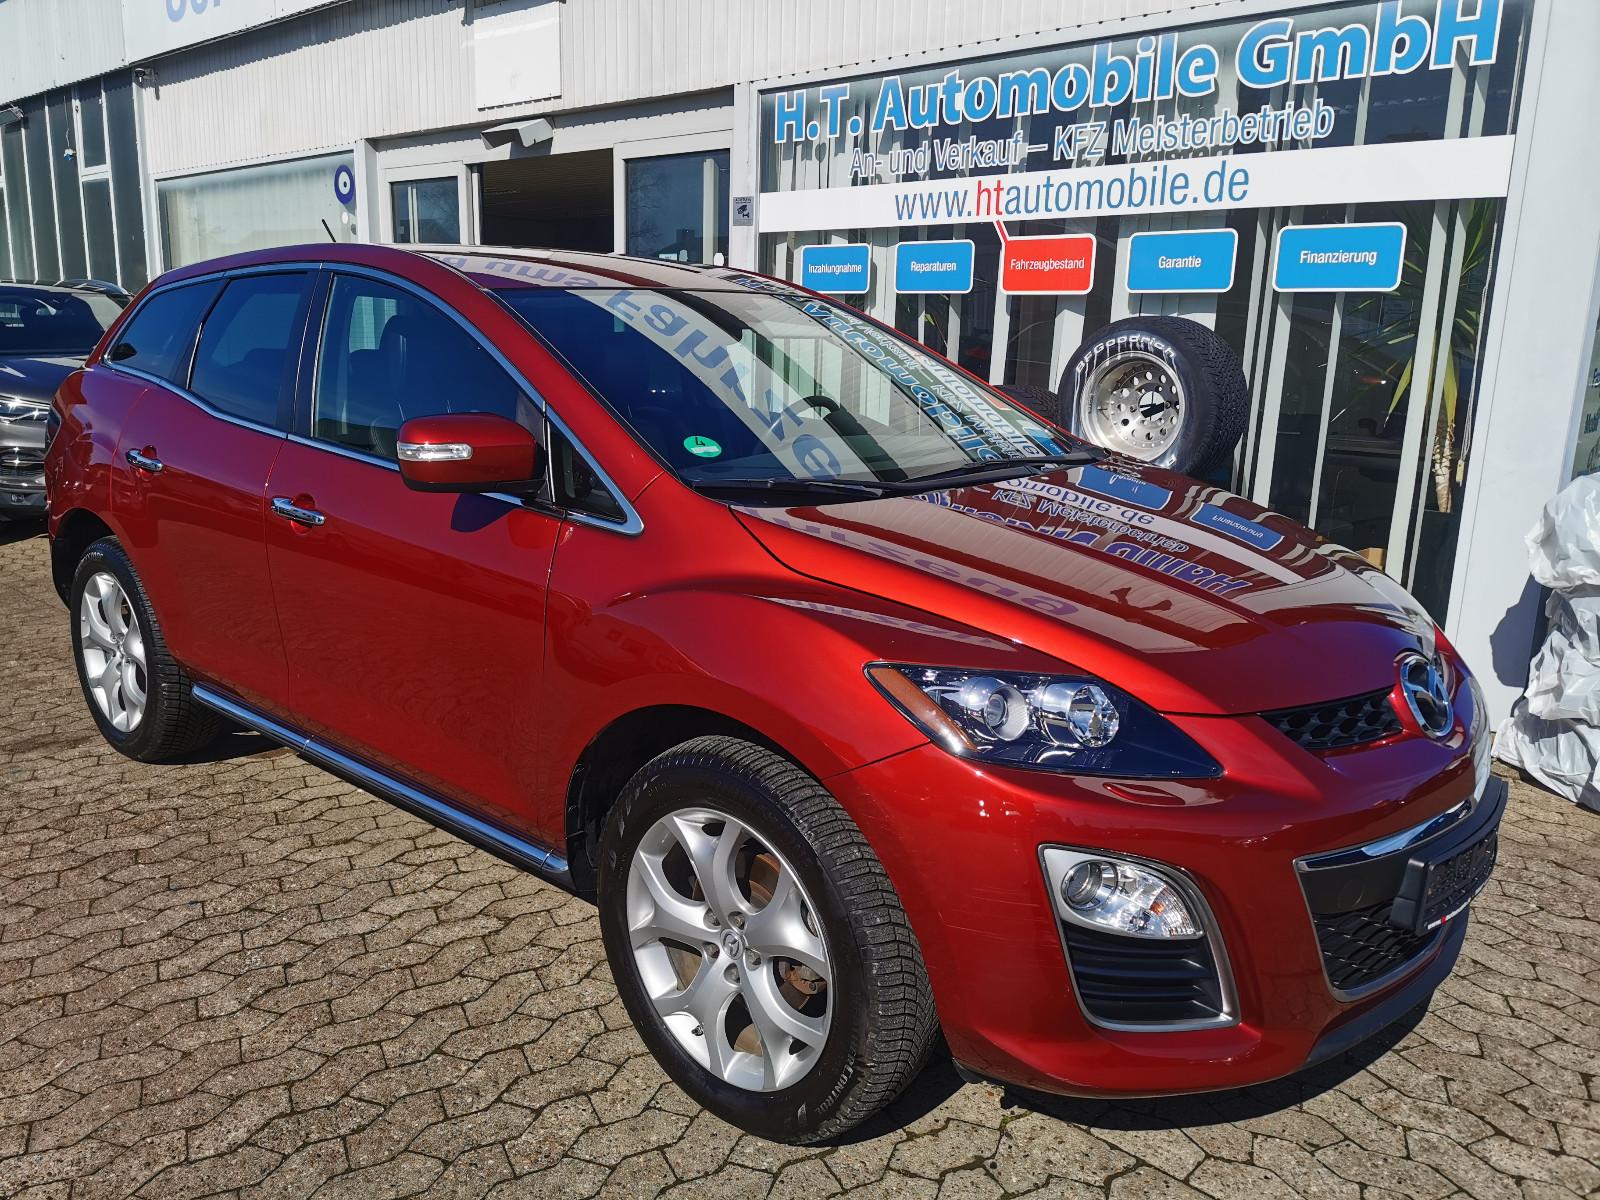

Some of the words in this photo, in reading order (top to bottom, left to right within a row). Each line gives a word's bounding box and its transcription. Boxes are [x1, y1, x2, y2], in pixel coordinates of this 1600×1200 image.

[774, 83, 862, 144] H.T.
[870, 32, 1219, 134] Automobile
[1235, 0, 1502, 89] GmbH
[849, 147, 882, 178] An-
[889, 141, 929, 176] und
[933, 131, 1023, 172] Verkauf
[1053, 121, 1105, 160] KFZ
[1112, 98, 1335, 156] Meisterbetrieb
[894, 160, 1250, 221] www.htautomobile.de
[1009, 257, 1085, 272] Fahrzeugbestand
[1158, 255, 1202, 269] Garantie
[1299, 249, 1377, 266] Finanzierung
[808, 262, 862, 276] Inzahlungnahme
[910, 259, 957, 274] Reparaturen
